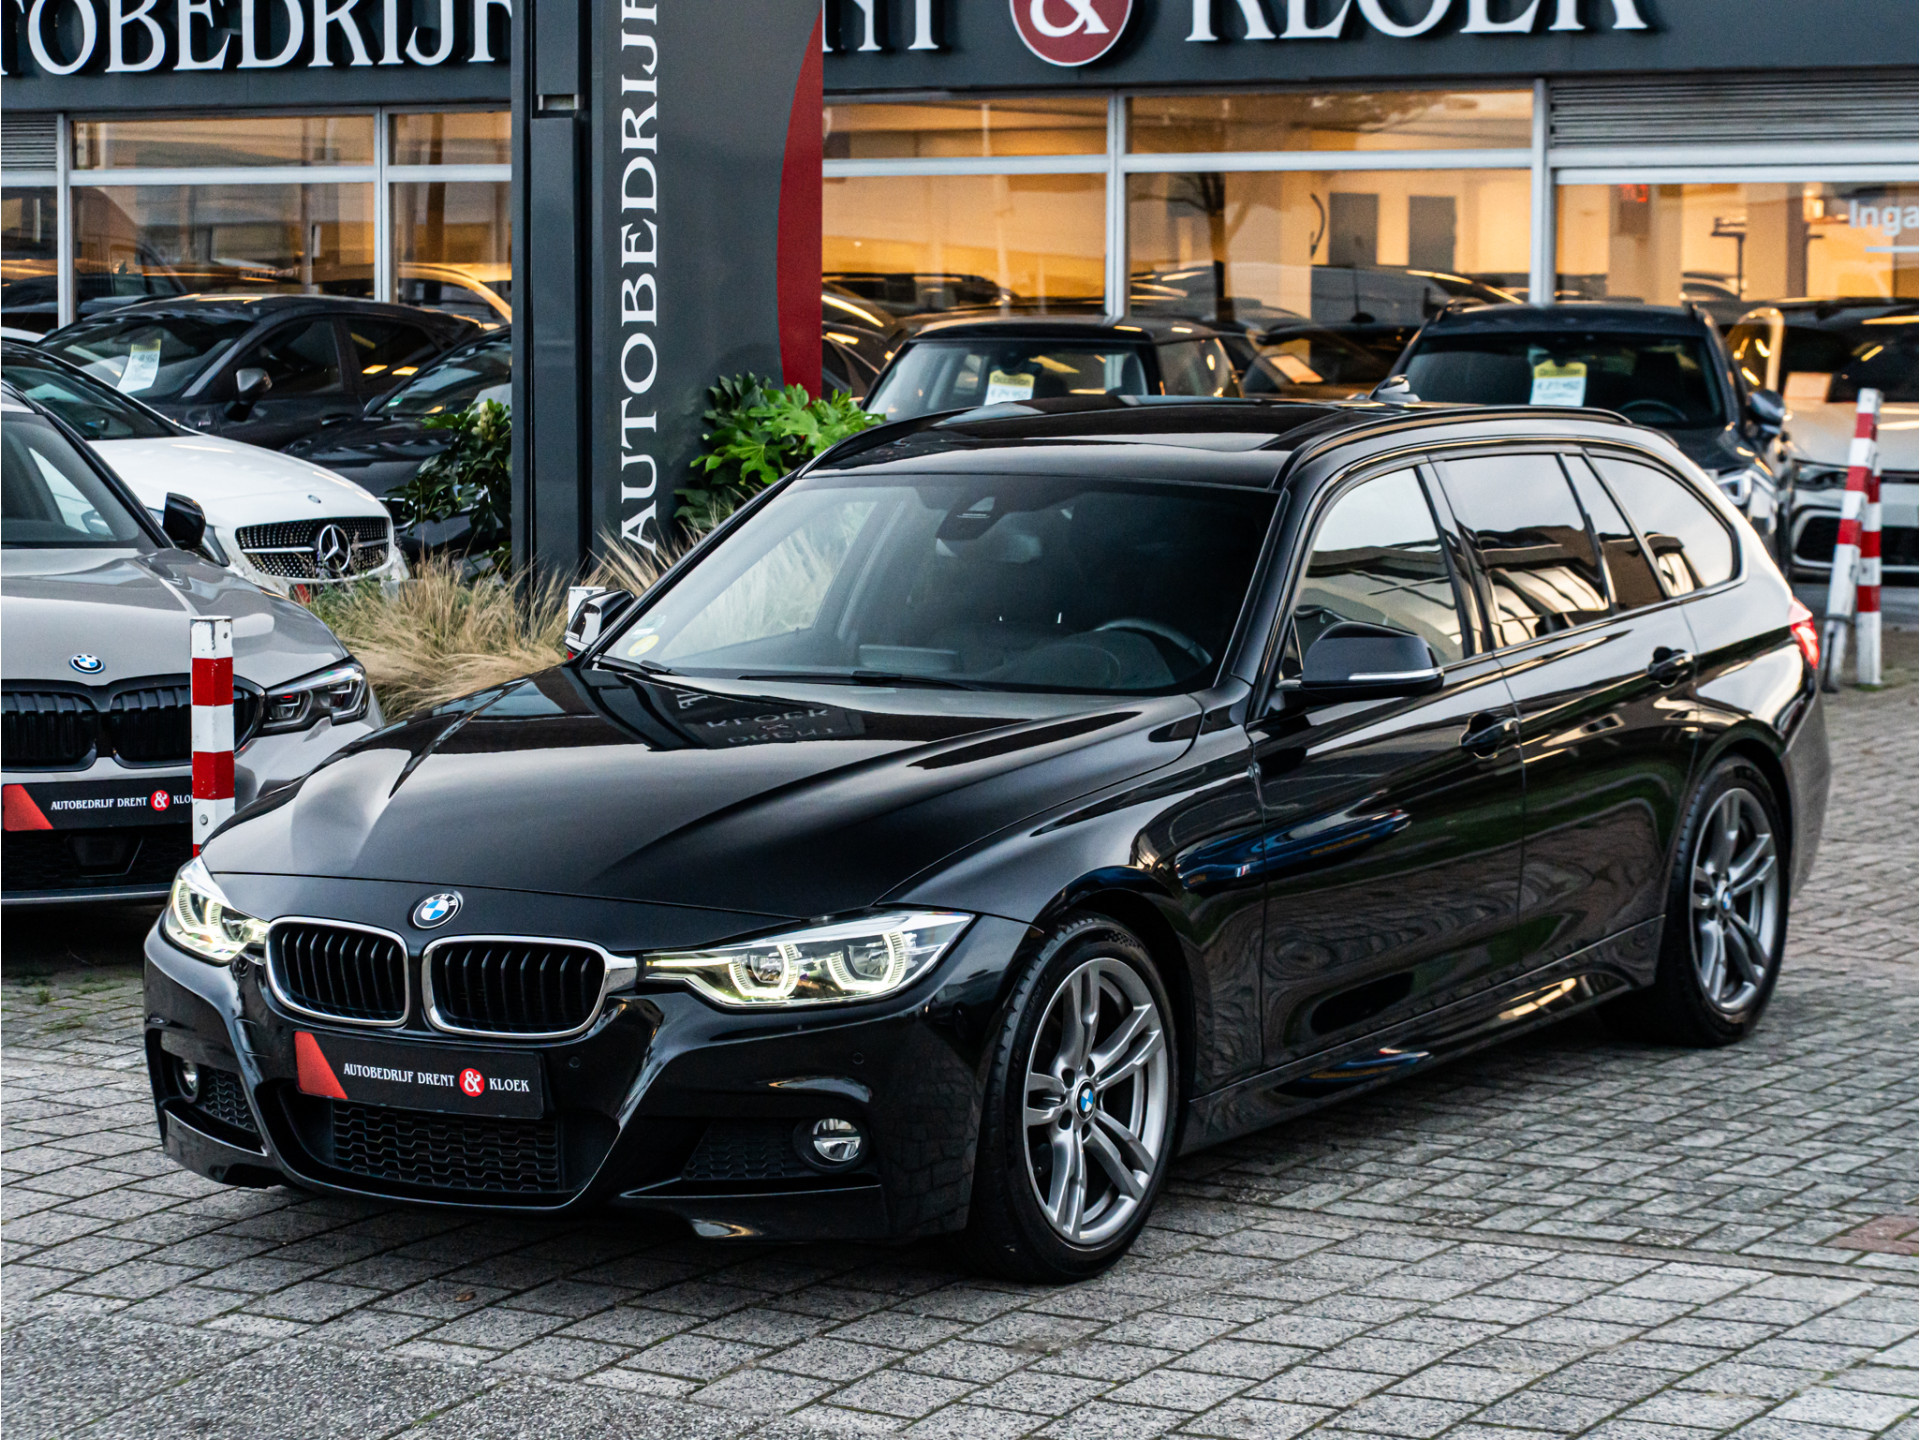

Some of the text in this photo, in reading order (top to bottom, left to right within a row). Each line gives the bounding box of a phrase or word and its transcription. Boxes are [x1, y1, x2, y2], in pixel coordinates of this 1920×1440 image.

[621, 0, 658, 556] AUTOBEDRIJF
[51, 798, 115, 810] AUTOBEDRIJF
[117, 796, 147, 808] DRENT
[153, 791, 168, 808] &
[343, 1062, 530, 1093] AUTOBEDRIJF DRENT & KLOEK
